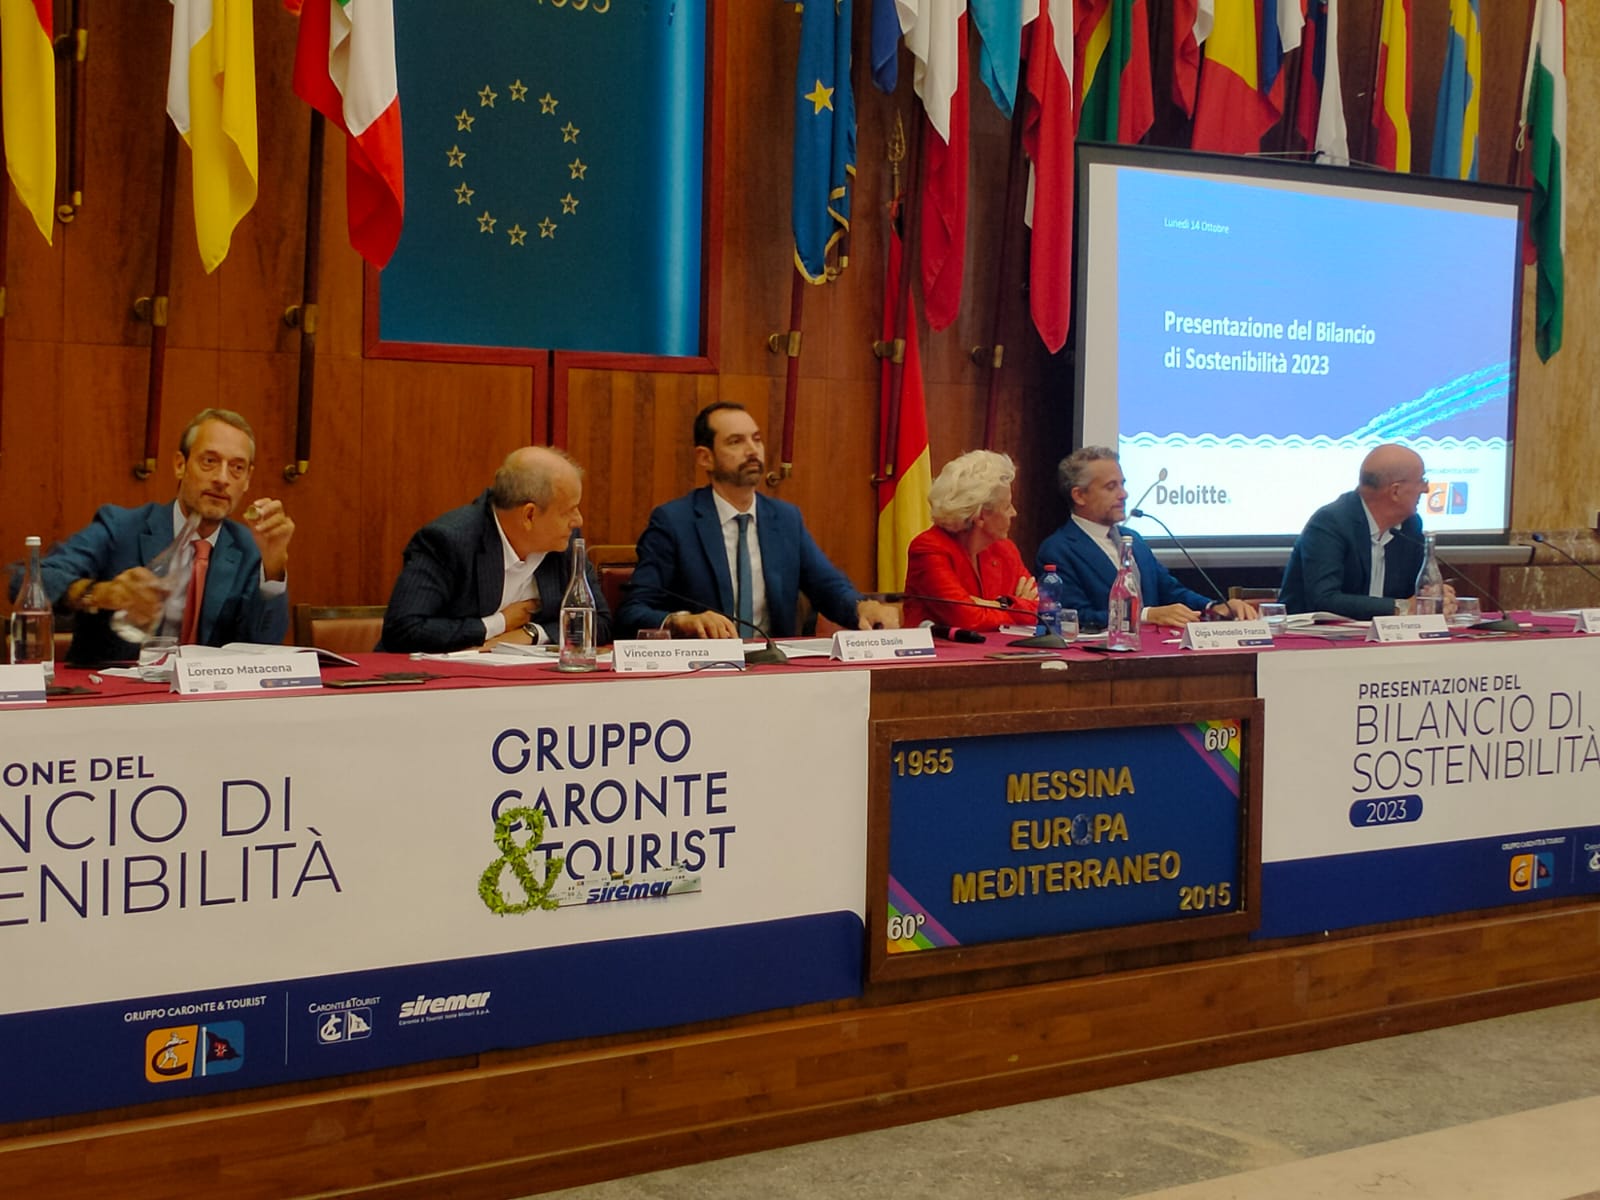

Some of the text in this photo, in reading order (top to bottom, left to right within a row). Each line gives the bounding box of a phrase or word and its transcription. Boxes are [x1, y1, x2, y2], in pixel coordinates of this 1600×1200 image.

[1191, 219, 1200, 231] 14
[1201, 221, 1230, 234] Ottobre
[1164, 310, 1376, 345] Presentazione del Bilancio
[1164, 346, 1330, 375] di Sostenibilità 2023
[846, 636, 904, 647] Federico Basile
[1244, 627, 1266, 635] Franza
[624, 648, 709, 658] Vincenzo Franza
[187, 664, 293, 677] Lorenzo Matacena
[1358, 674, 1521, 700] PRESENTAZIONE DEL
[1356, 690, 1582, 746] BILANCIO DI
[491, 719, 691, 774] GRUPPO
[1352, 724, 1600, 793] SOSTENIBILITÀ
[2, 755, 154, 787] ONE DEL
[893, 748, 954, 777] 1955
[1007, 766, 1135, 804] MESSINA
[221, 776, 291, 837] DI
[1366, 799, 1407, 824] 2023
[1011, 812, 1128, 851] EUROPA
[586, 880, 673, 904] siremar
[952, 850, 1181, 905] MEDITERRANEO
[1179, 882, 1231, 911] 2015
[124, 995, 267, 1022] GRUPPO CARONTE & TOURIST
[398, 991, 491, 1018] siremar
